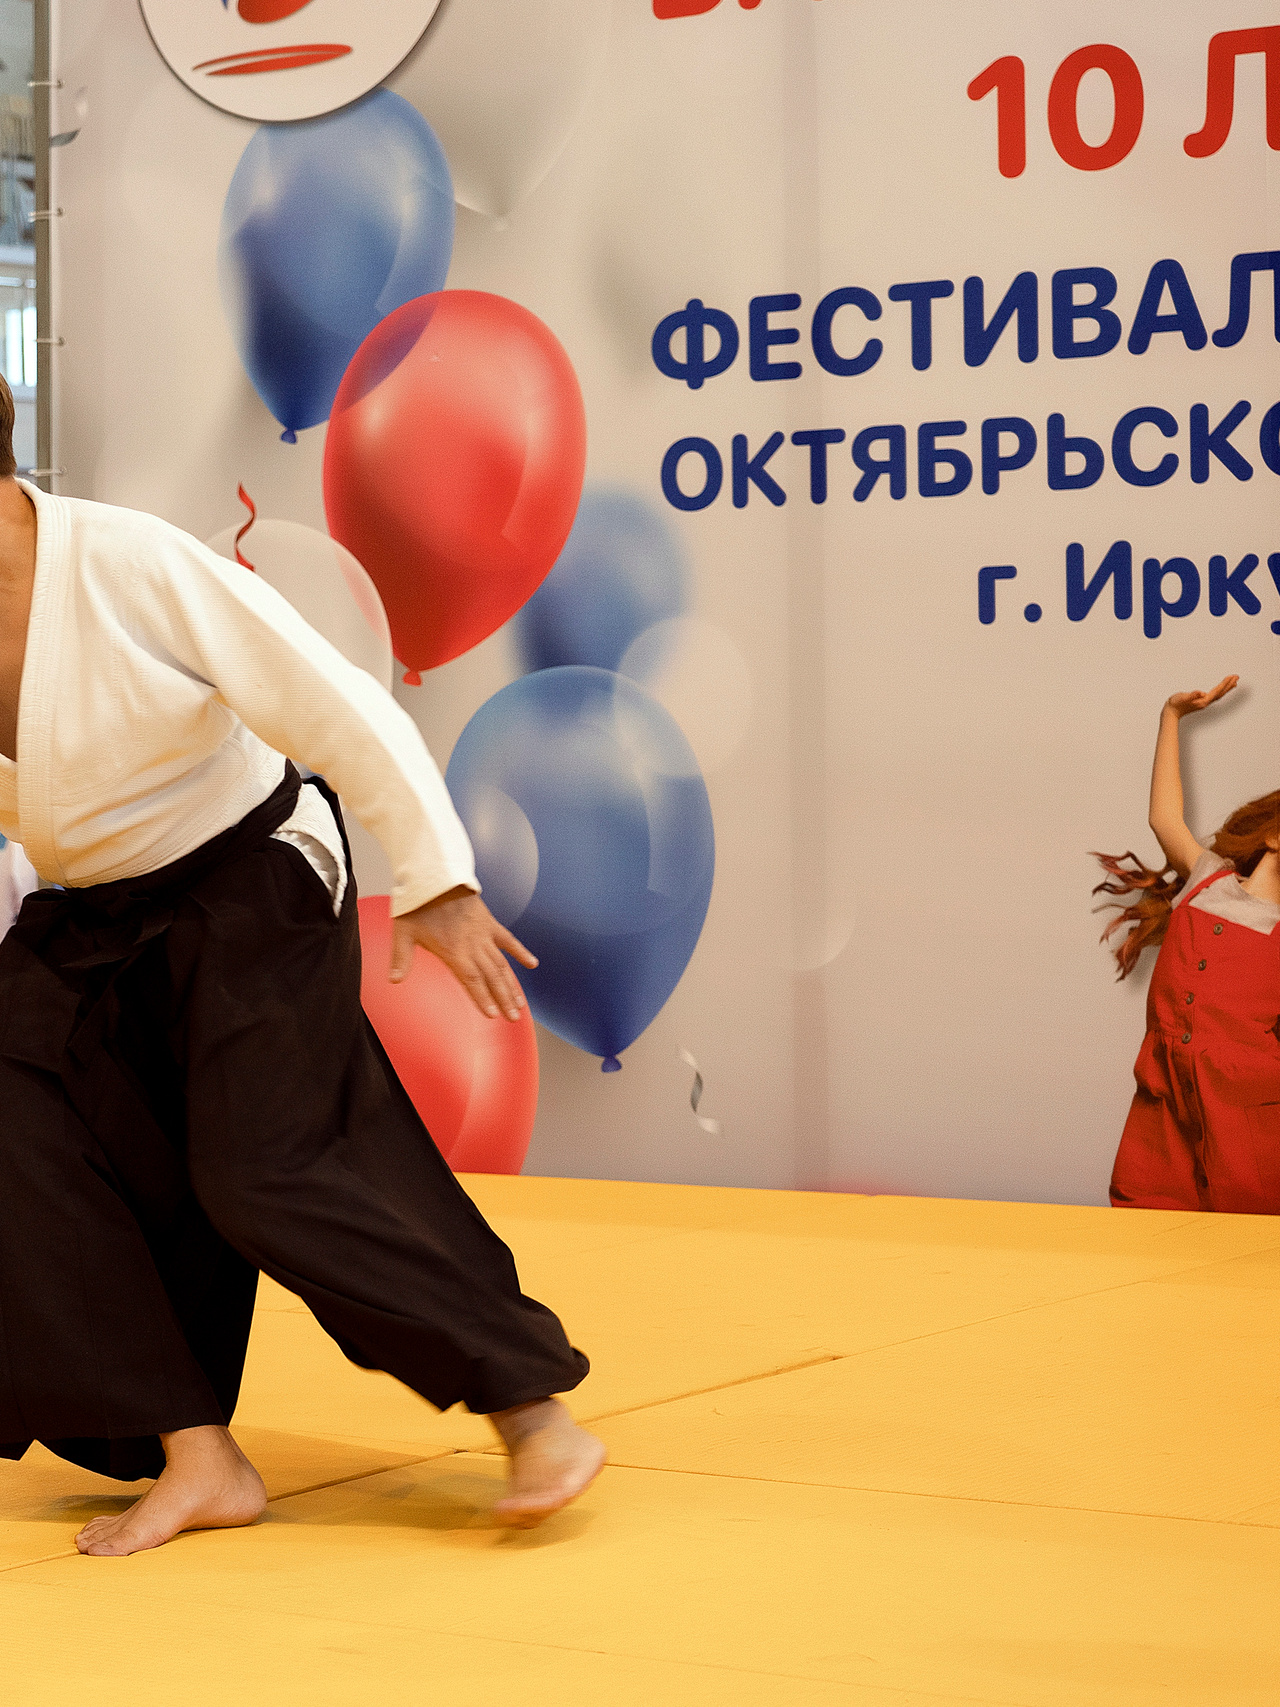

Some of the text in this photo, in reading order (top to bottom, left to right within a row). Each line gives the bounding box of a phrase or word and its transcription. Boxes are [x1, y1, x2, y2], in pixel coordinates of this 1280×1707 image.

[967, 43, 1145, 179] 10
[651, 250, 1280, 390] ФЕСТИВАЛ
[1065, 540, 1280, 640] Ирк
